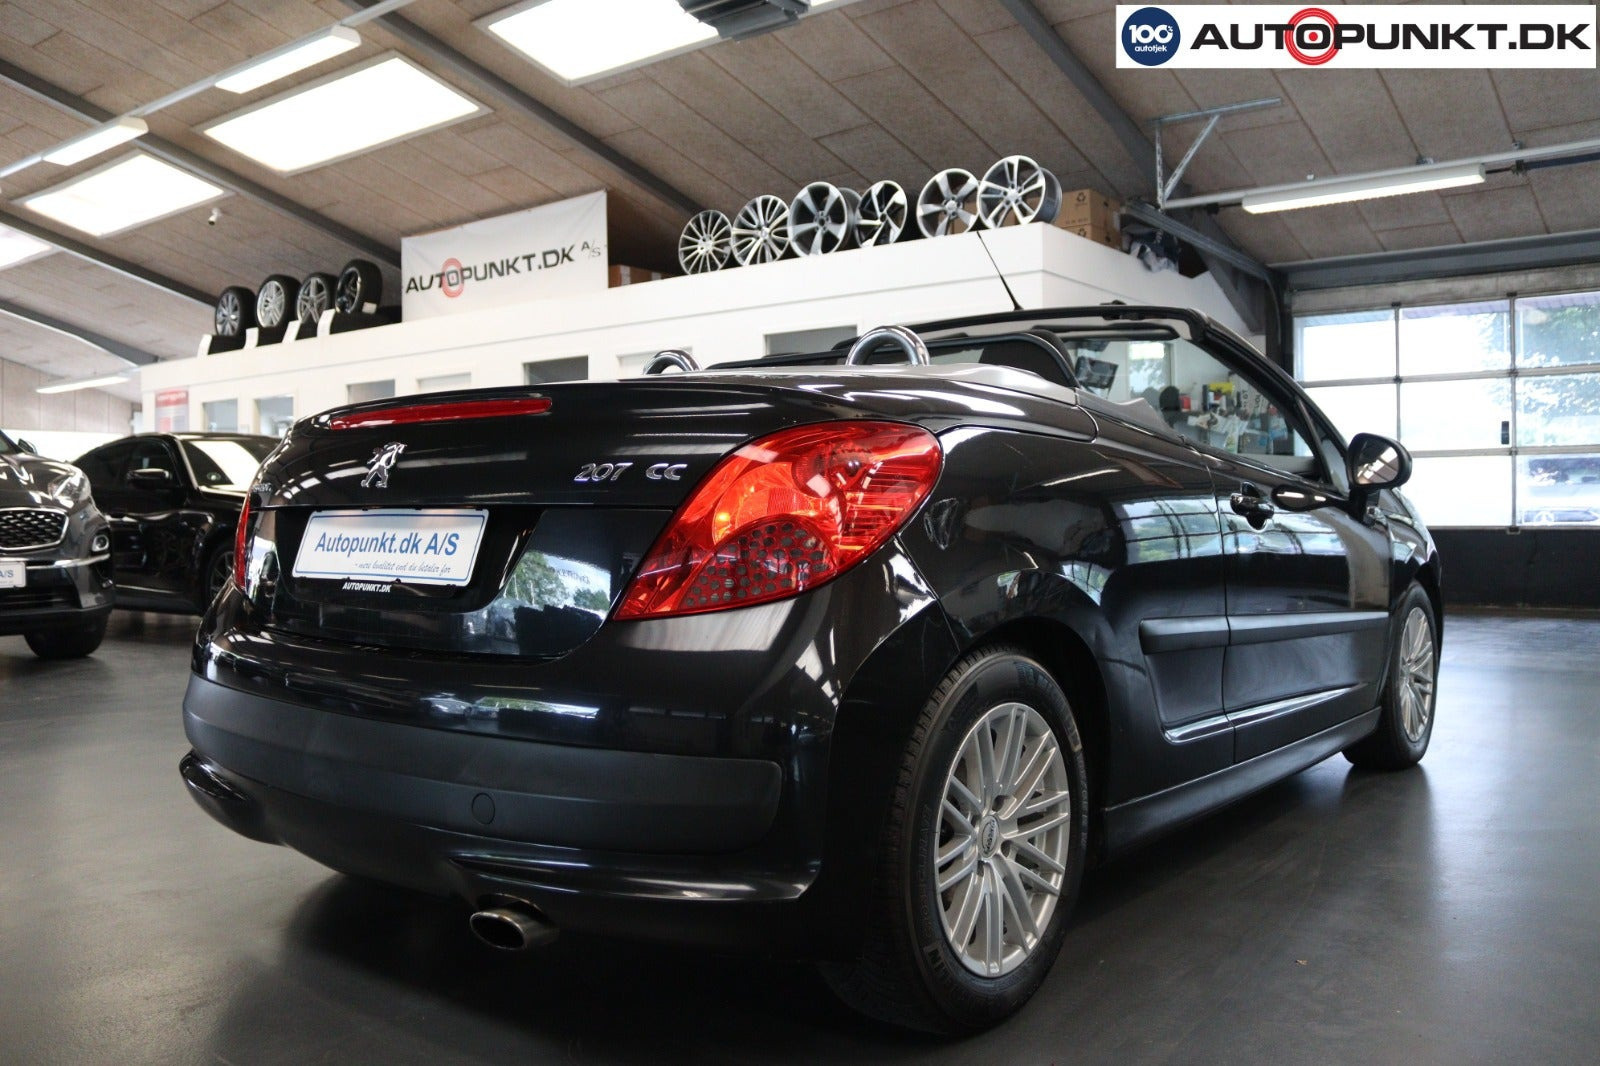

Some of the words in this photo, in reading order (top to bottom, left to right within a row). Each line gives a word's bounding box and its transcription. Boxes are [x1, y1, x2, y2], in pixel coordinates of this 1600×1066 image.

[405, 244, 576, 294] AUTOPUNKT.DK
[574, 463, 633, 482] 207
[645, 463, 688, 481] CC
[314, 531, 423, 558] Autopunkt.dk
[424, 532, 460, 556] A/S
[342, 582, 392, 593] AUTOPUNKT.DK
